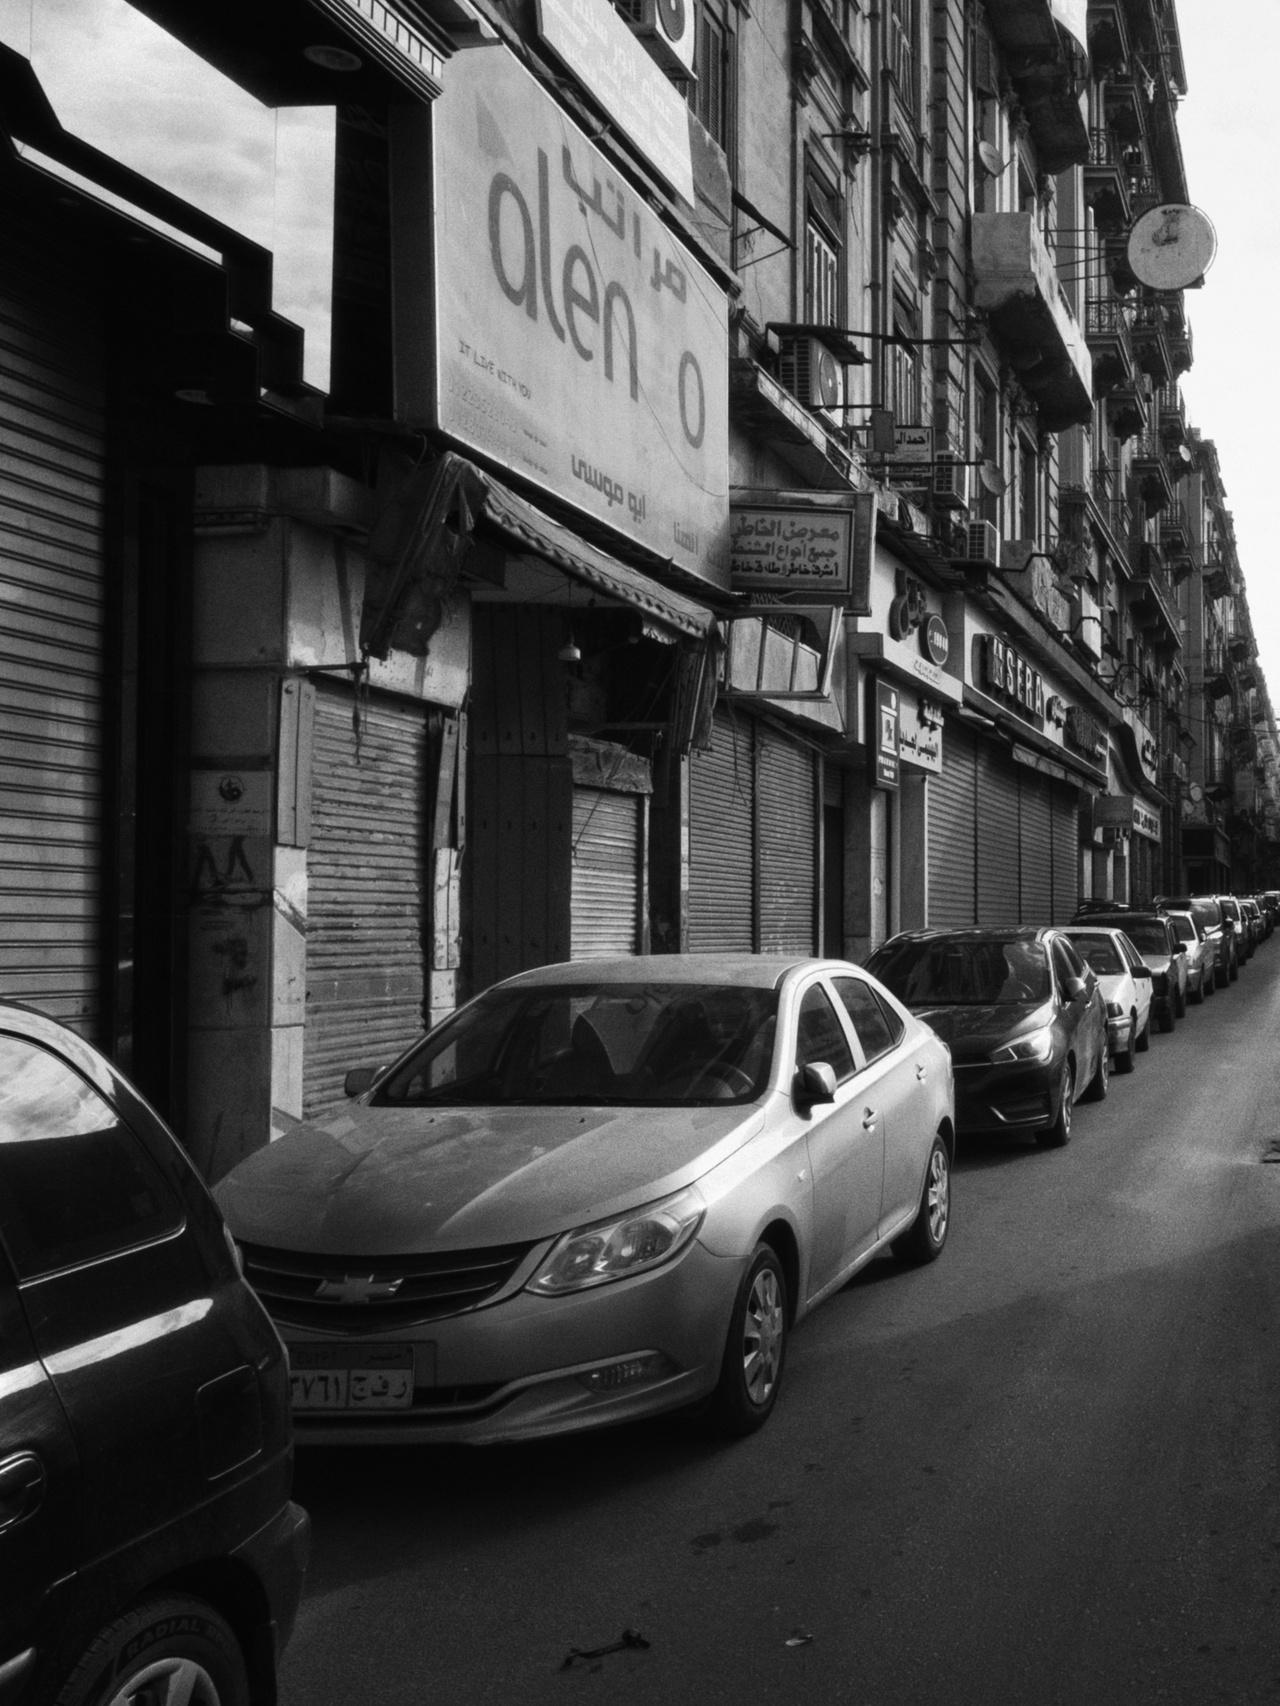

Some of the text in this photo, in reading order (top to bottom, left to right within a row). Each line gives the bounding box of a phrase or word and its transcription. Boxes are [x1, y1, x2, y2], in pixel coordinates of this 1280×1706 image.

[571, 454, 624, 507] موسى
[783, 520, 840, 542] معرض
[808, 546, 838, 562] جميع
[296, 1350, 337, 1365] EGYPT
[366, 1352, 402, 1365] مصر
[126, 1617, 201, 1659] RADIAL
